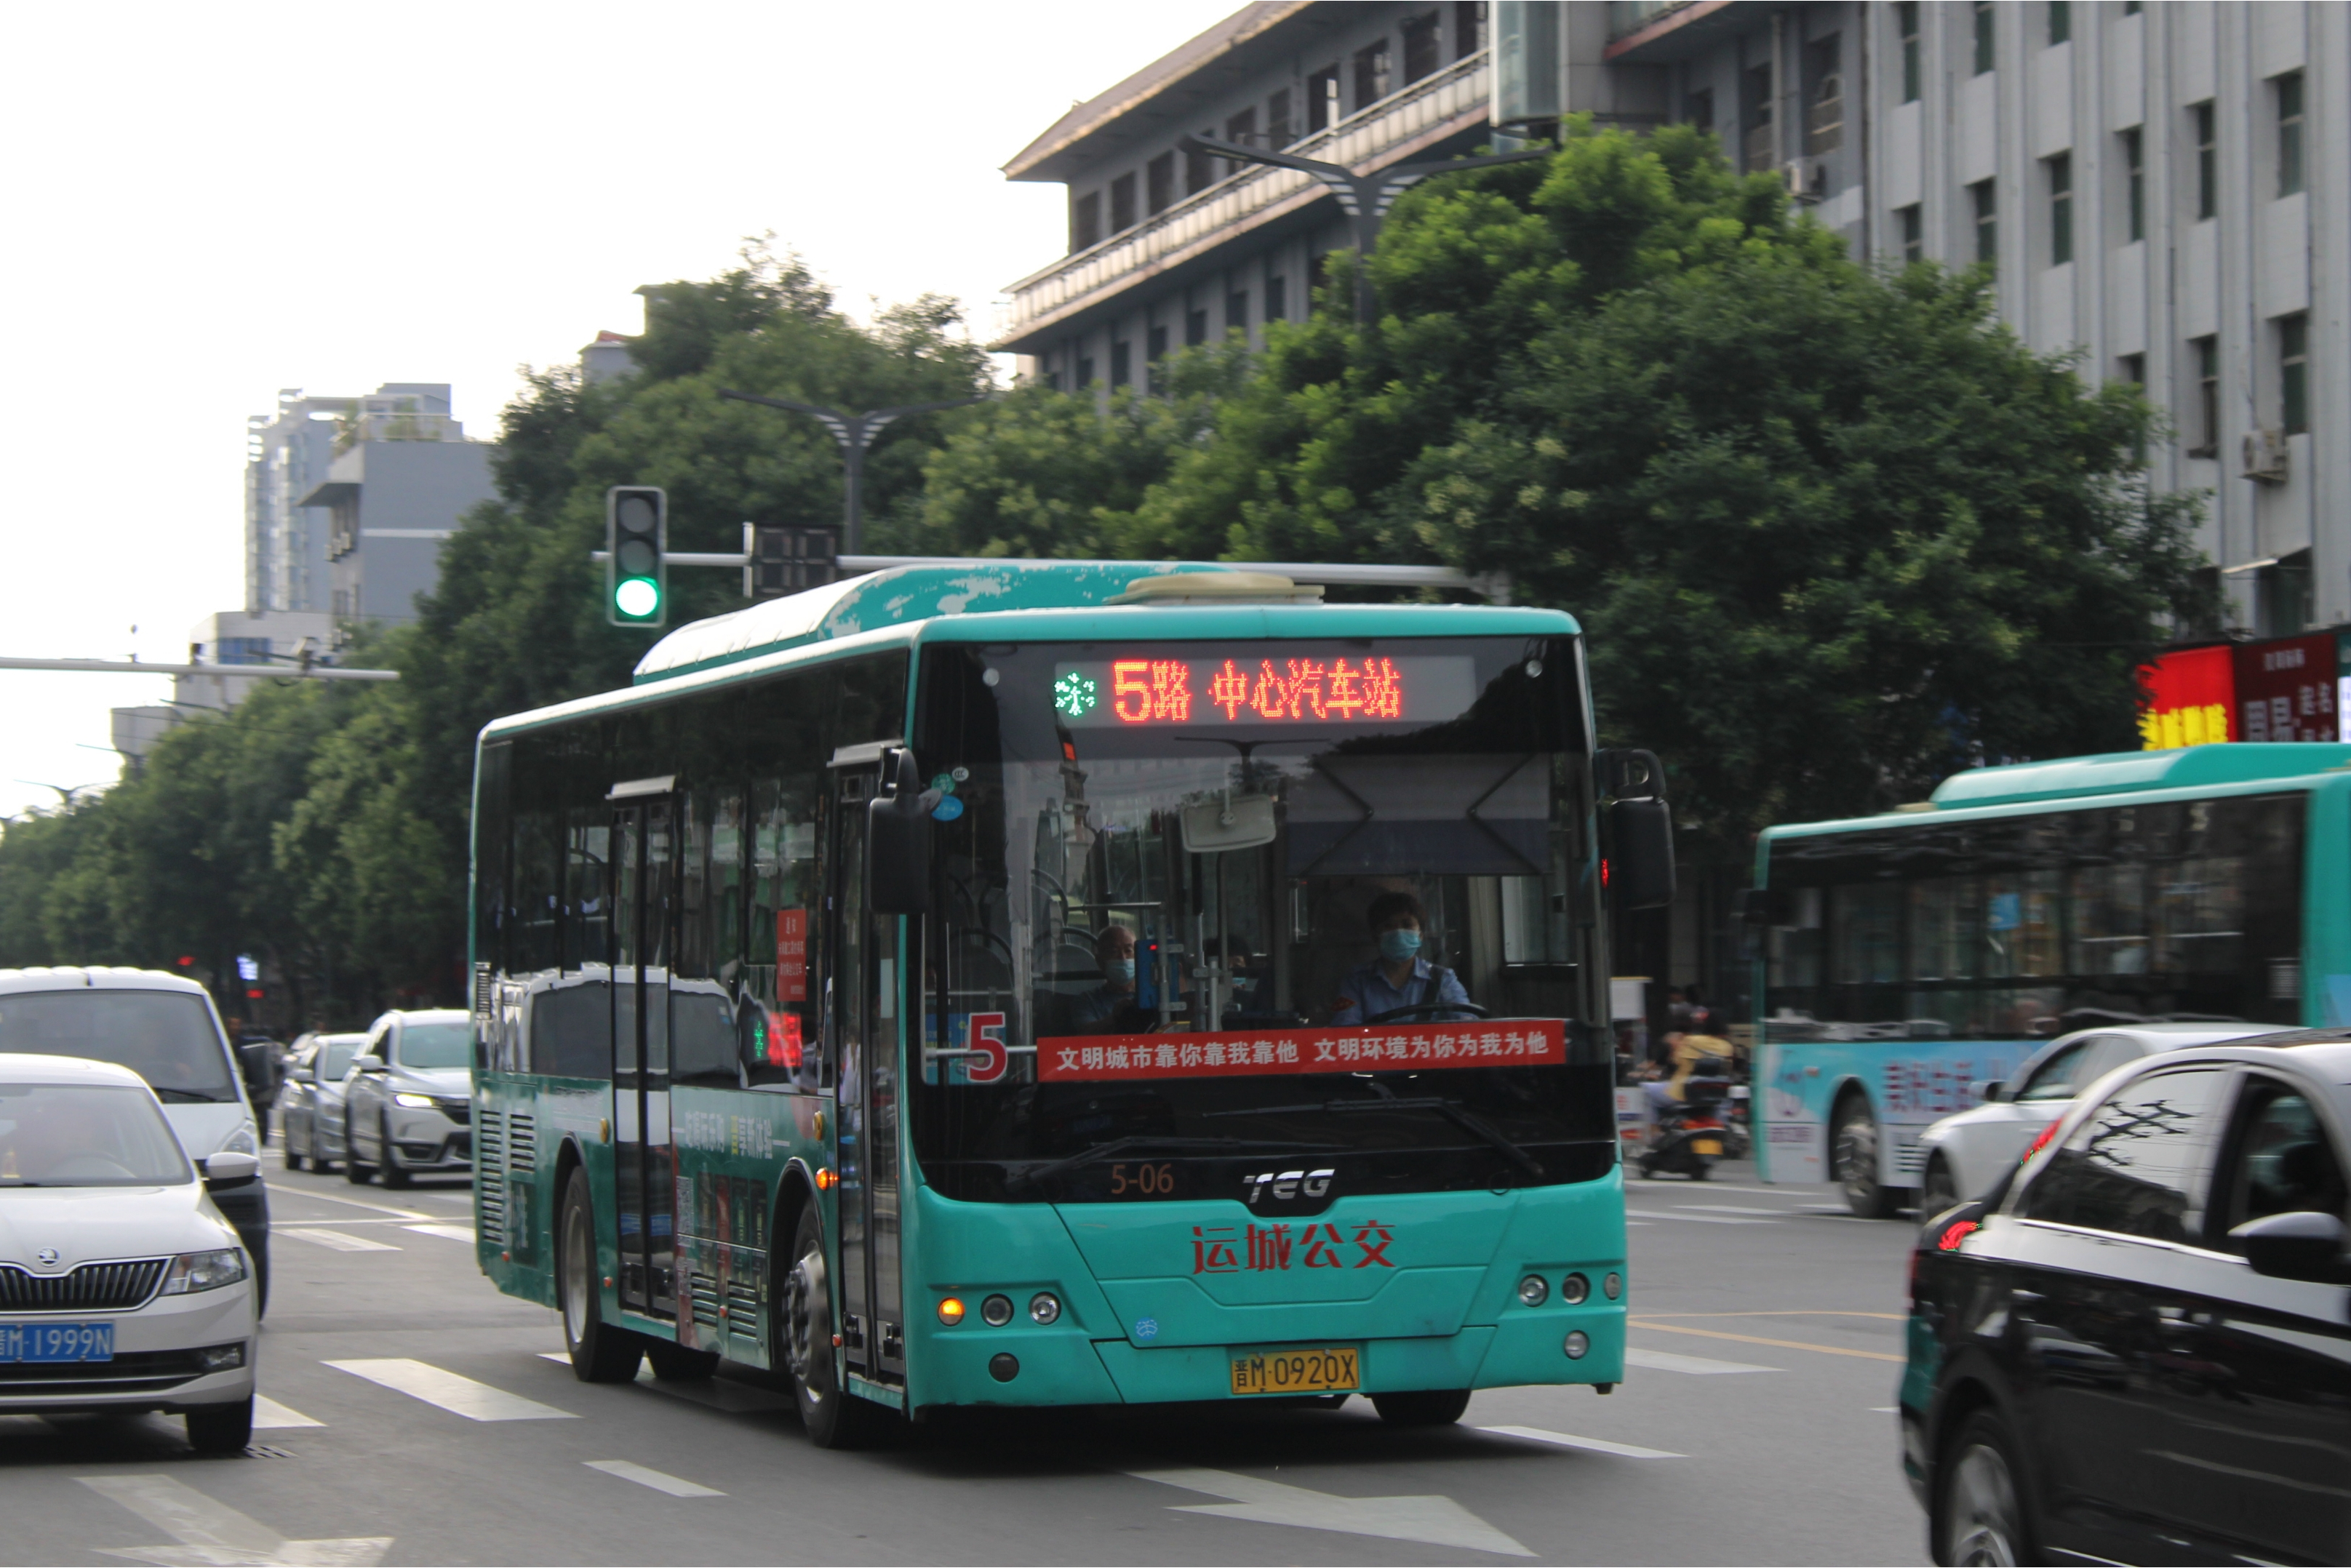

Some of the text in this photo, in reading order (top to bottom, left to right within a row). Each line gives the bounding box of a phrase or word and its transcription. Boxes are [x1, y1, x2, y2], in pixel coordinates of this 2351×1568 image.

[1114, 659, 1400, 721] 5路 中心汽车站
[967, 1012, 1007, 1082] 5
[1056, 1031, 1549, 1071] 文明城市靠你靠我靠他 文明环境为你为我为他
[1111, 1163, 1173, 1194] 5-06
[1242, 1168, 1335, 1204] TEG
[1190, 1219, 1396, 1276] 运城公交
